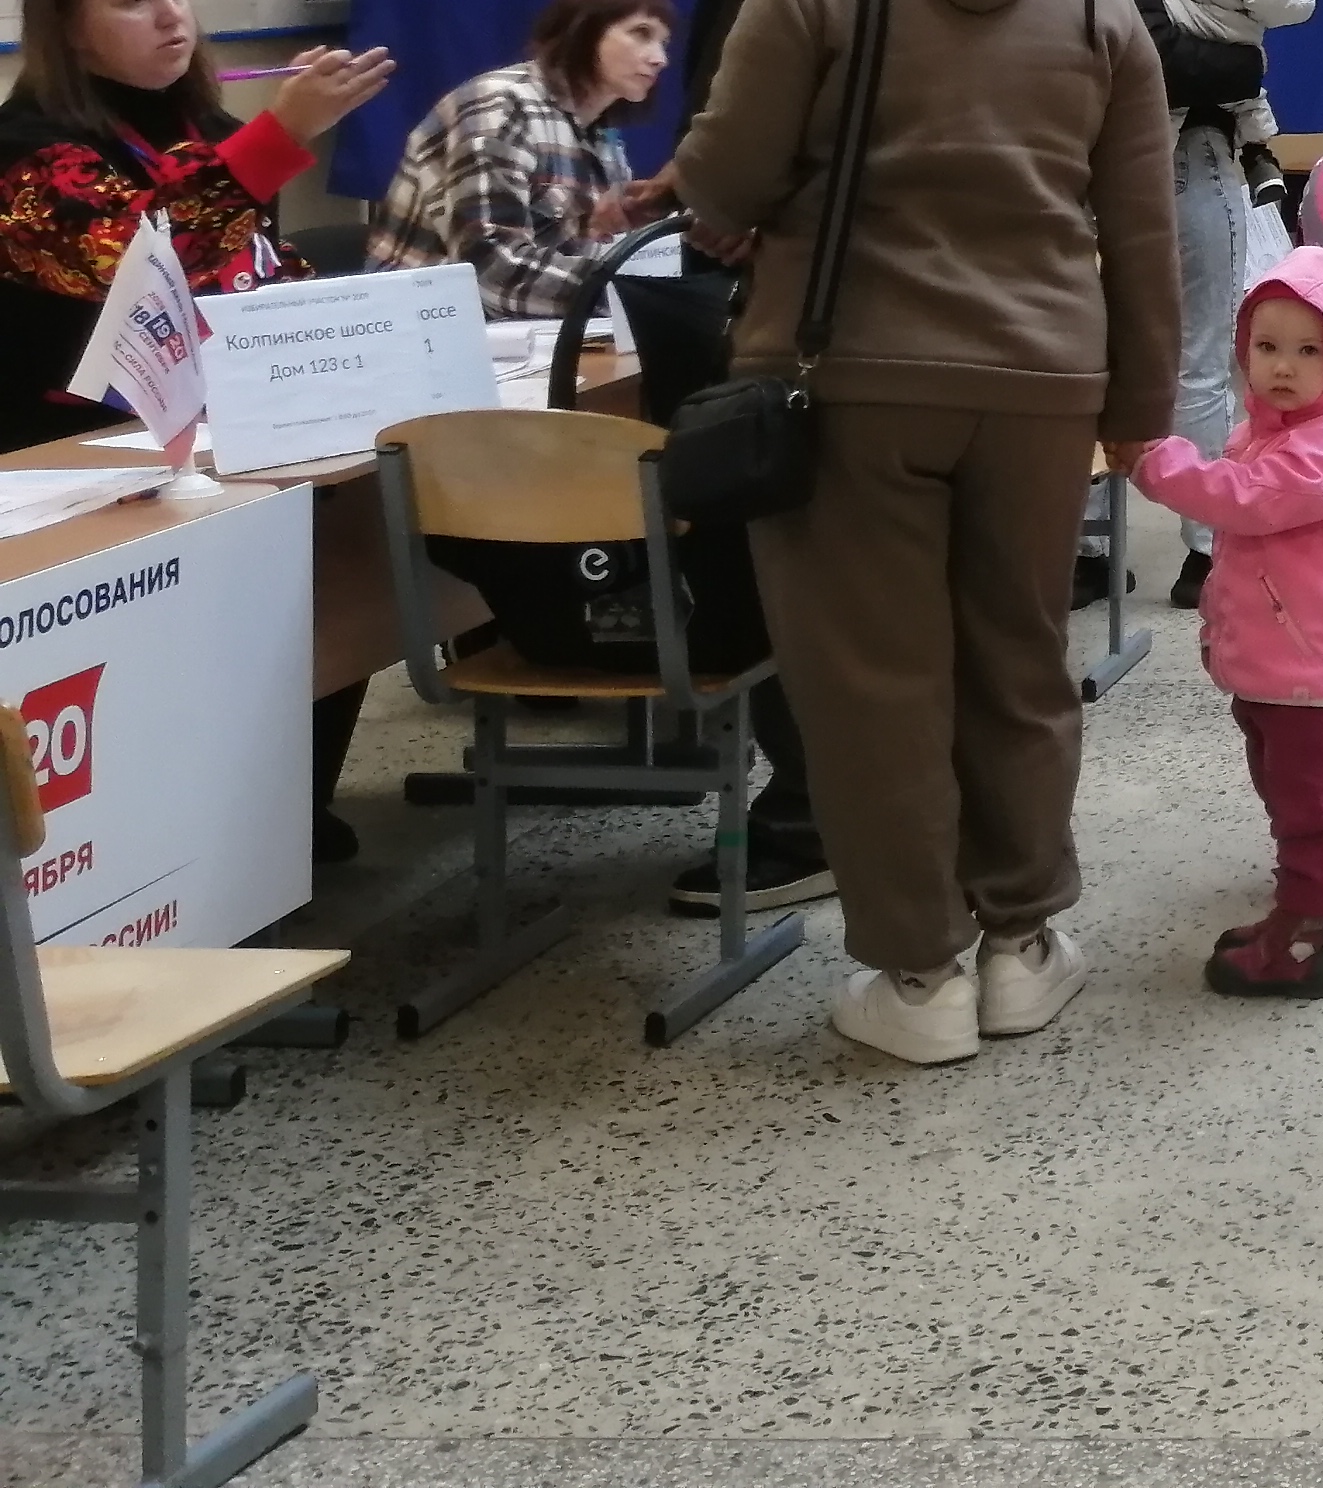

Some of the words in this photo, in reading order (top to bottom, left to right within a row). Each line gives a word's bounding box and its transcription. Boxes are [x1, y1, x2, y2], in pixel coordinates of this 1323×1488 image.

[129, 304, 151, 325] 18
[151, 317, 171, 339] 19
[417, 305, 457, 321] оссе
[225, 326, 335, 351] Колпинское
[340, 320, 393, 338] шоссе
[270, 363, 305, 382] Дом
[309, 357, 338, 374] 123
[0, 557, 181, 648] ОЛОСОВАНИЯ
